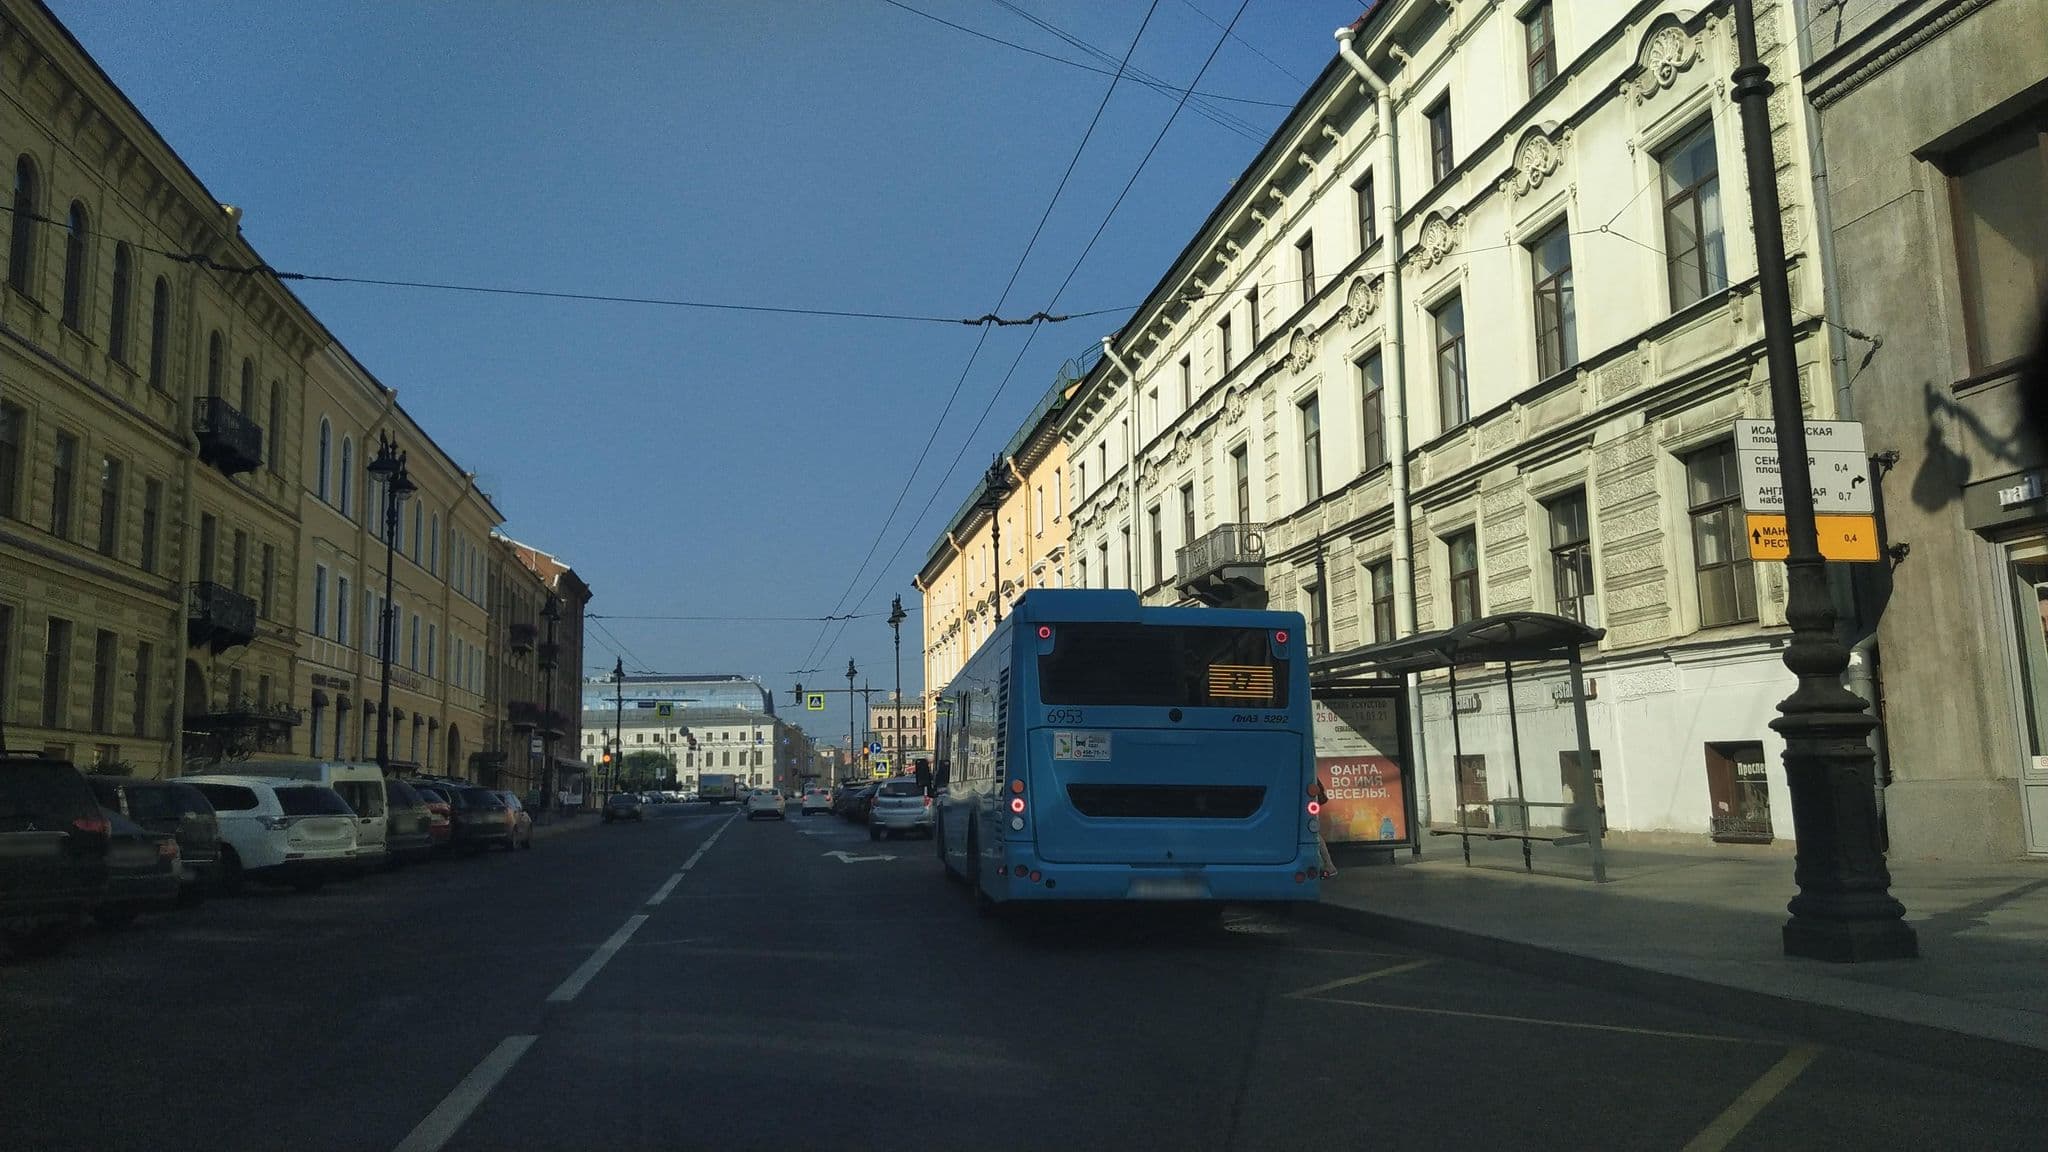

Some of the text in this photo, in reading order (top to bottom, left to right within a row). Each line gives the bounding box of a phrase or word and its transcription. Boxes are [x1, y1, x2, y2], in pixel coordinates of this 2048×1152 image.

[1751, 425, 1832, 437] ИСААСКАЯ
[1754, 457, 1815, 466] СЕНАЯ
[1756, 466, 1781, 474] площ
[1834, 463, 1848, 473] 0,4
[1758, 486, 1827, 497] АНГЛАЯ
[1838, 491, 1852, 501] 0,7
[1759, 495, 1819, 505] набея
[1844, 533, 1857, 543] 0,4
[1764, 539, 1789, 548] РЕСТ
[1047, 708, 1084, 724] 6953
[1264, 714, 1289, 724] 5292
[1330, 764, 1382, 775] ФАНТА.
[1332, 775, 1383, 787] ВО ИМЯ
[1326, 787, 1390, 800] ВЕСЕЛЬЯ.
